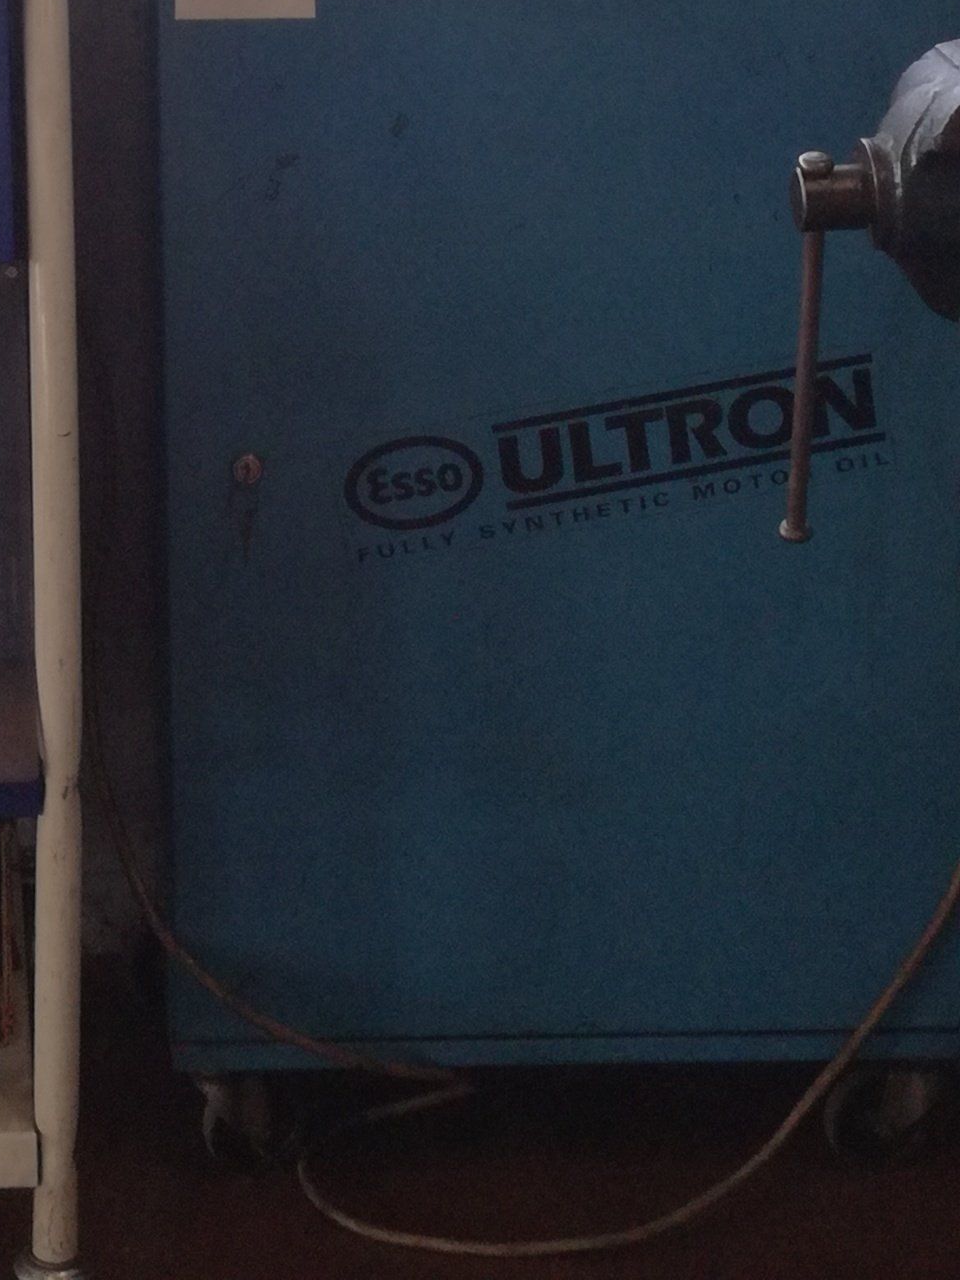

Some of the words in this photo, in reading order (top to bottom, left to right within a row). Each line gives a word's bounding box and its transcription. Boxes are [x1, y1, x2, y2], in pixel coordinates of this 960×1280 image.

[497, 368, 878, 495] ULTRON
[356, 530, 456, 563] FULLY
[479, 492, 670, 540] SYNTHETIC
[692, 463, 812, 501] MOTO
[835, 452, 890, 473] OIL
